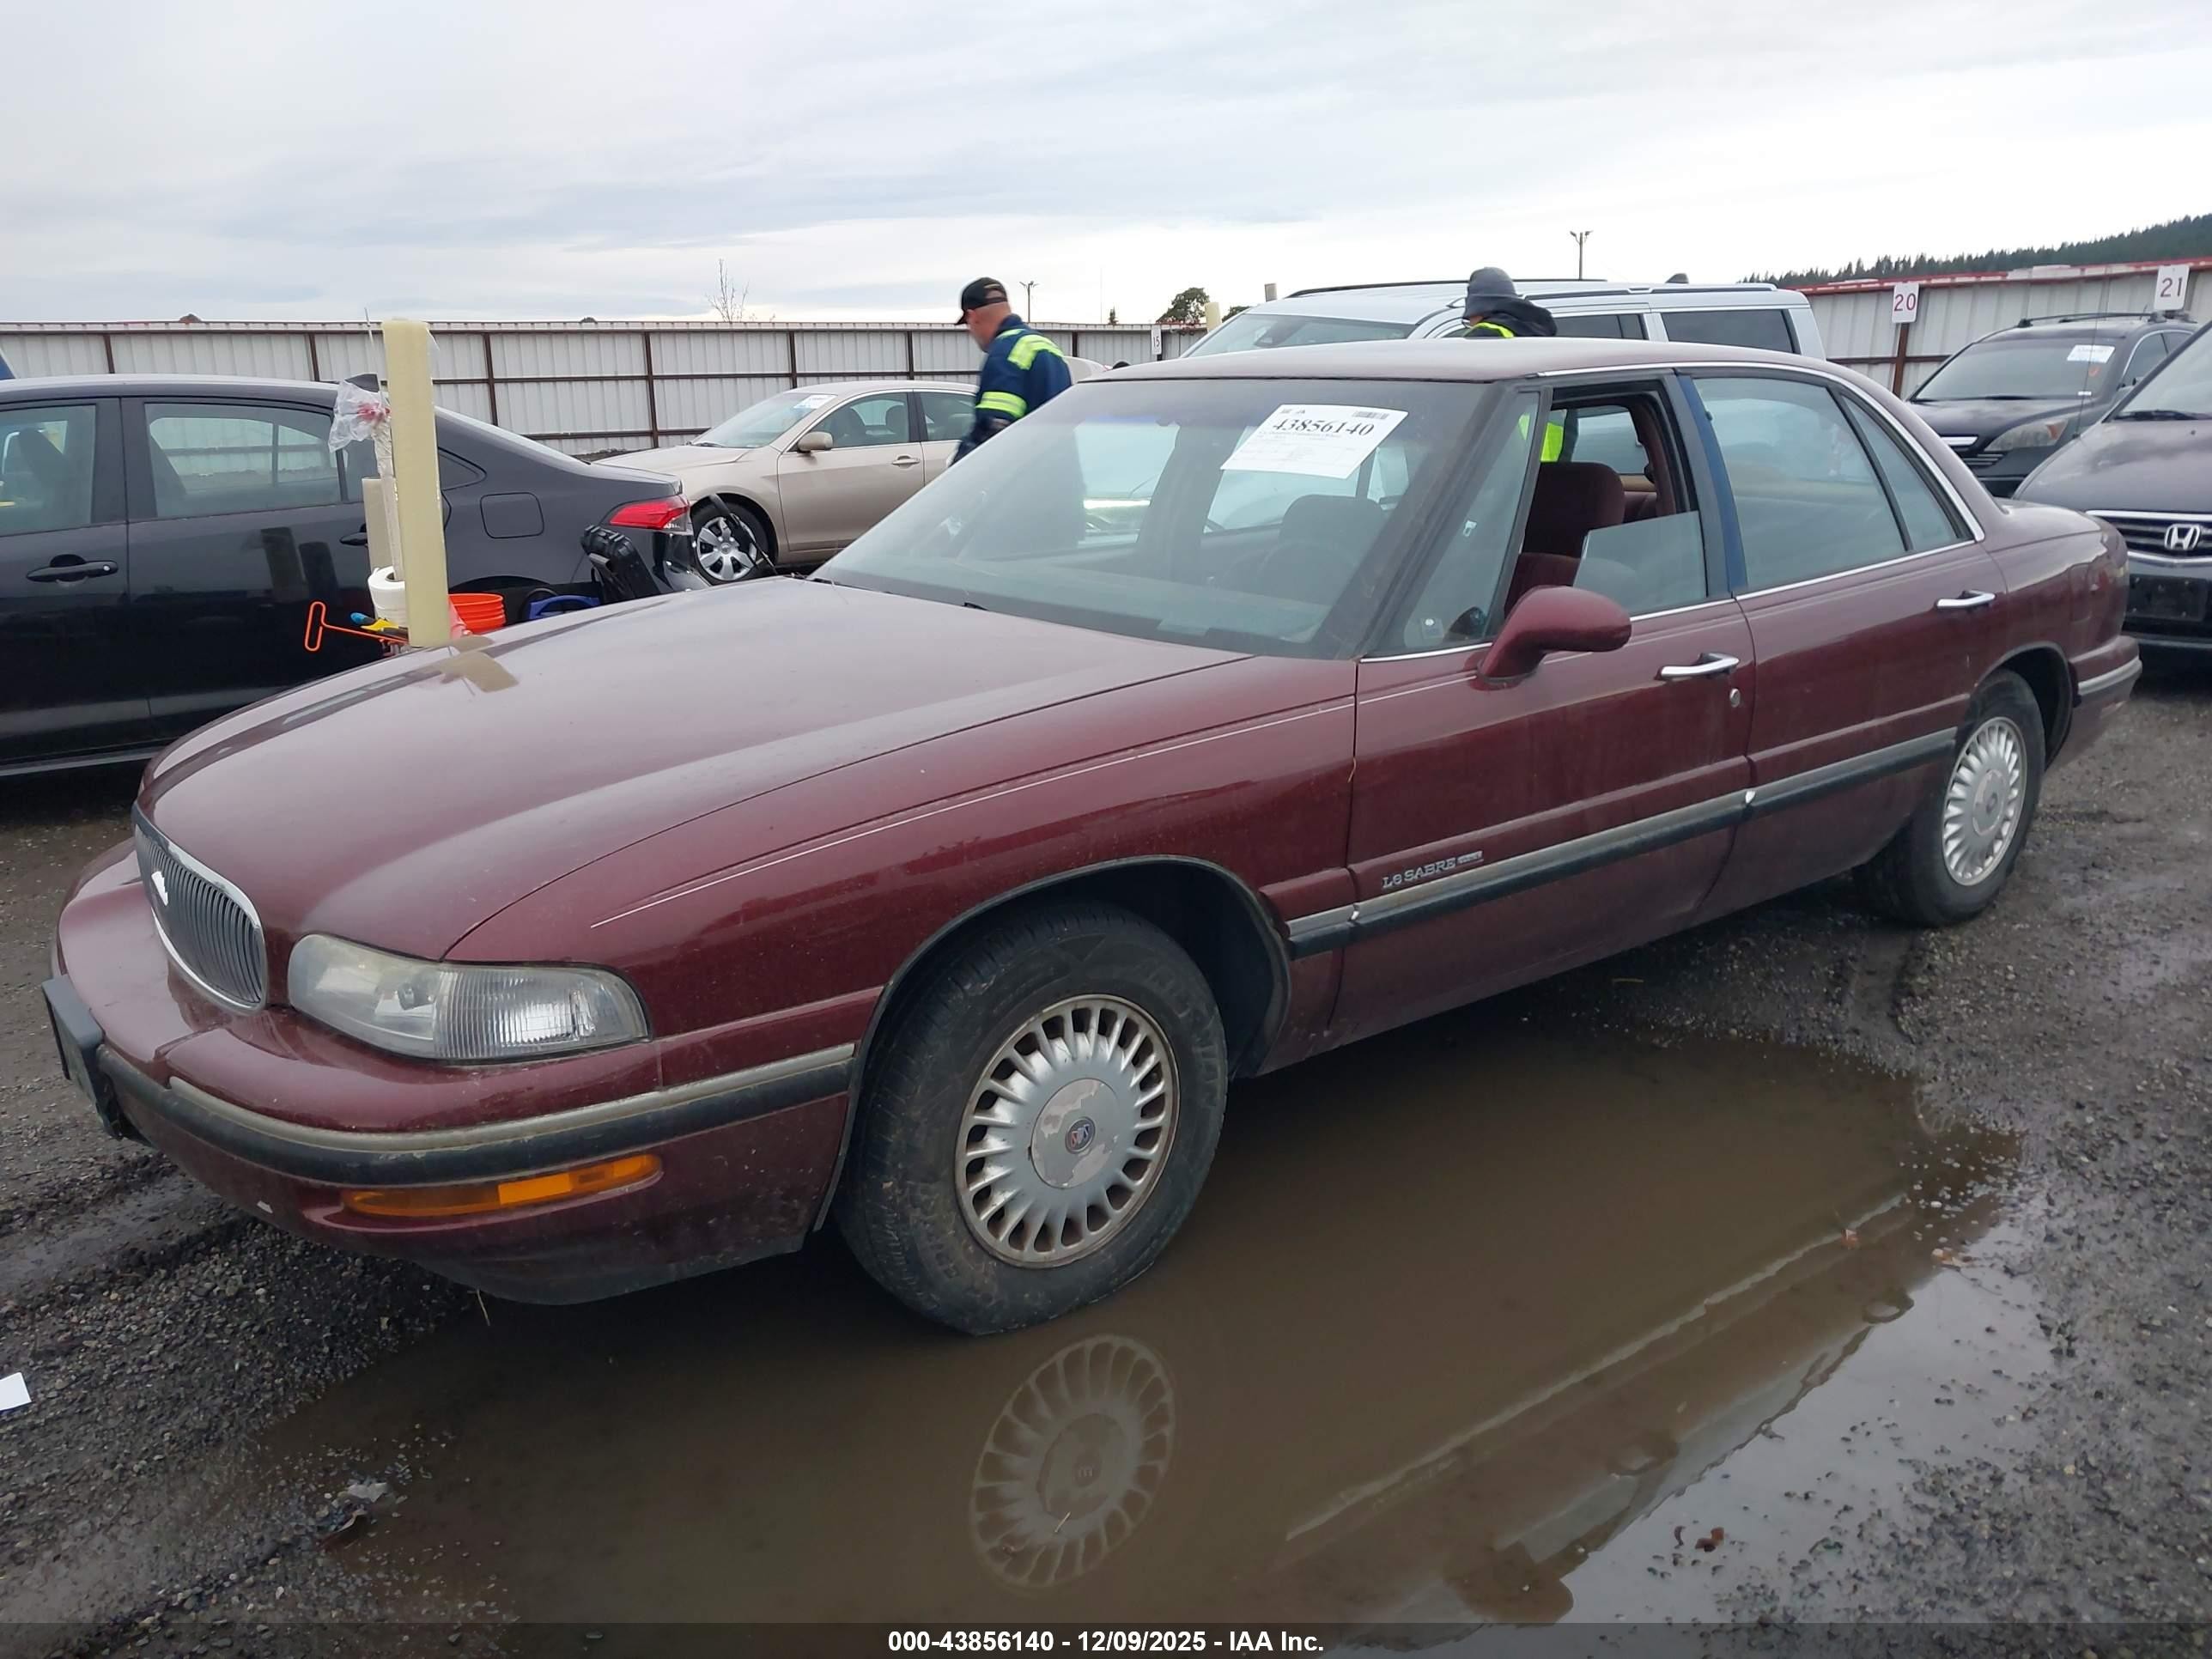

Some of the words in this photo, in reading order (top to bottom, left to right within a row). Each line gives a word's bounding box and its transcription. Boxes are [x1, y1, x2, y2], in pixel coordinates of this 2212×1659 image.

[2160, 277, 2183, 298] 21
[1893, 293, 1917, 312] 20
[1152, 336, 1160, 348] 15
[1273, 418, 1375, 436] 43856140
[1404, 857, 1456, 882] SABRE
